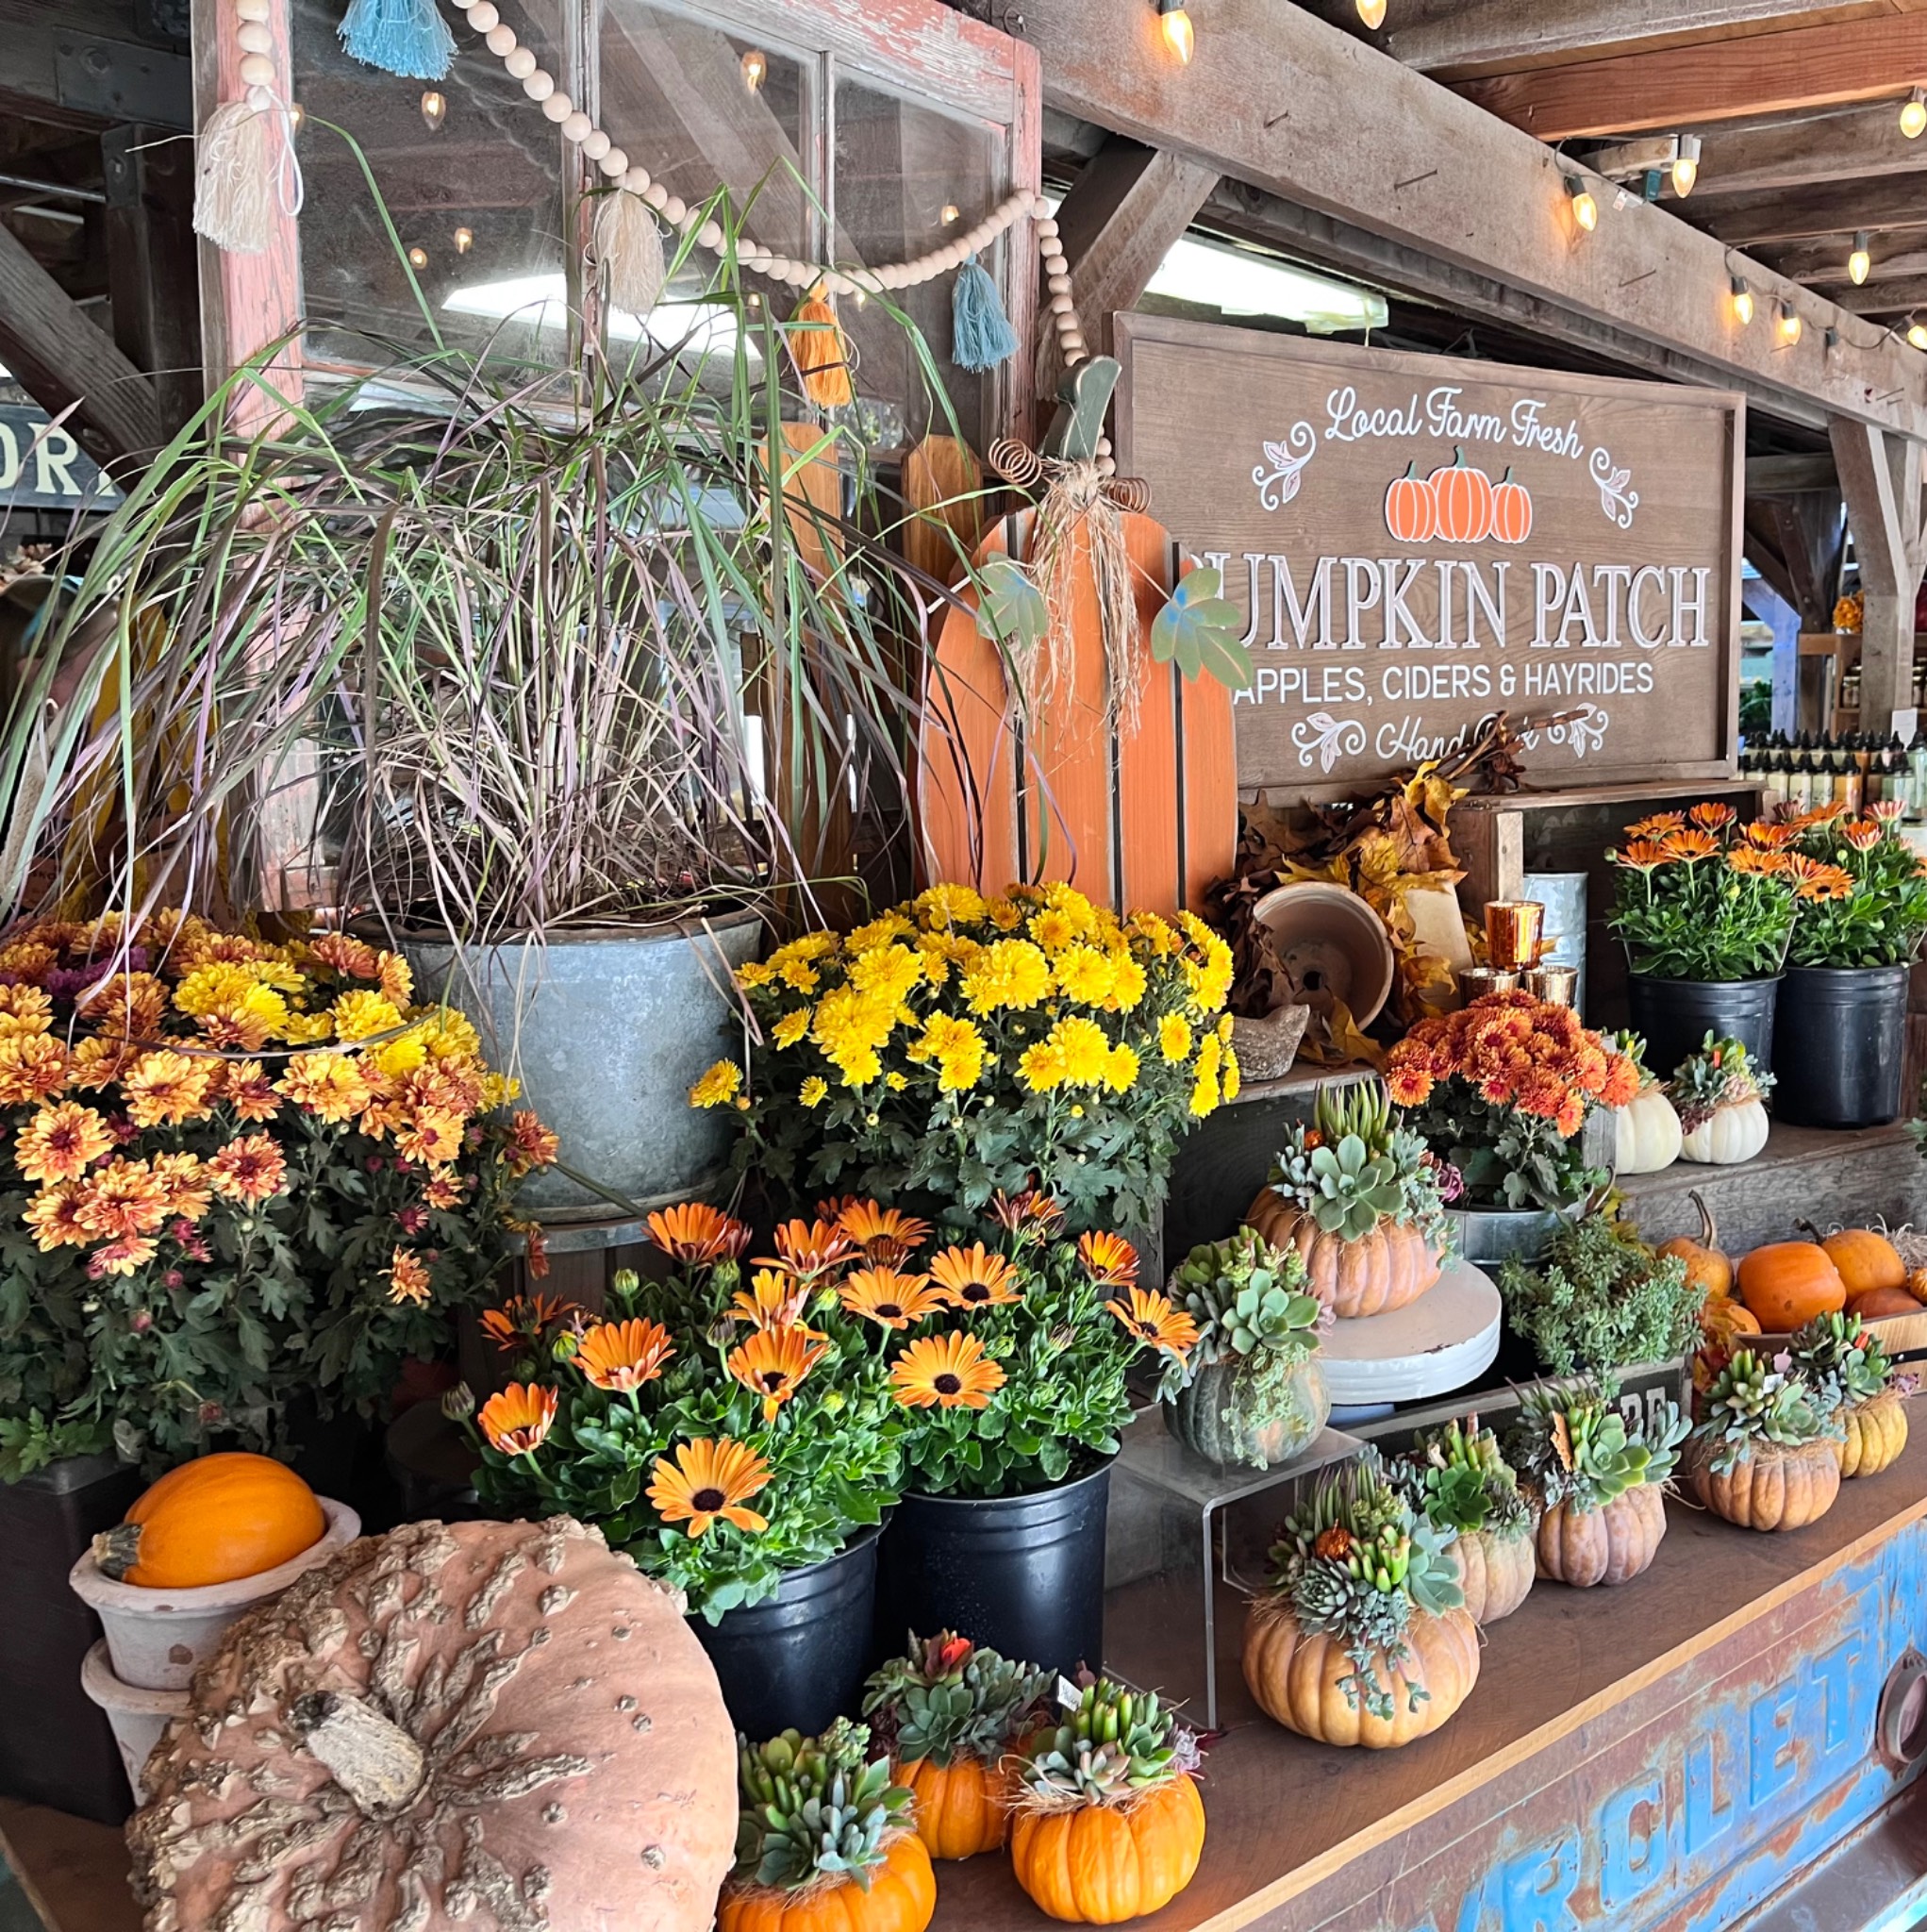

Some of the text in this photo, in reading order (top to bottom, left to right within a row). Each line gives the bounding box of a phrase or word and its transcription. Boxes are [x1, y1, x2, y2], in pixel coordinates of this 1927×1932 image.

[1324, 386, 1585, 458] Local Farm Fresh
[1190, 552, 1711, 650] UMPKIN PATCH
[1382, 664, 1490, 701] CIDERS
[1500, 663, 1517, 696] &
[1524, 662, 1654, 696] HAYRIDES
[1375, 715, 1467, 761] Hand
